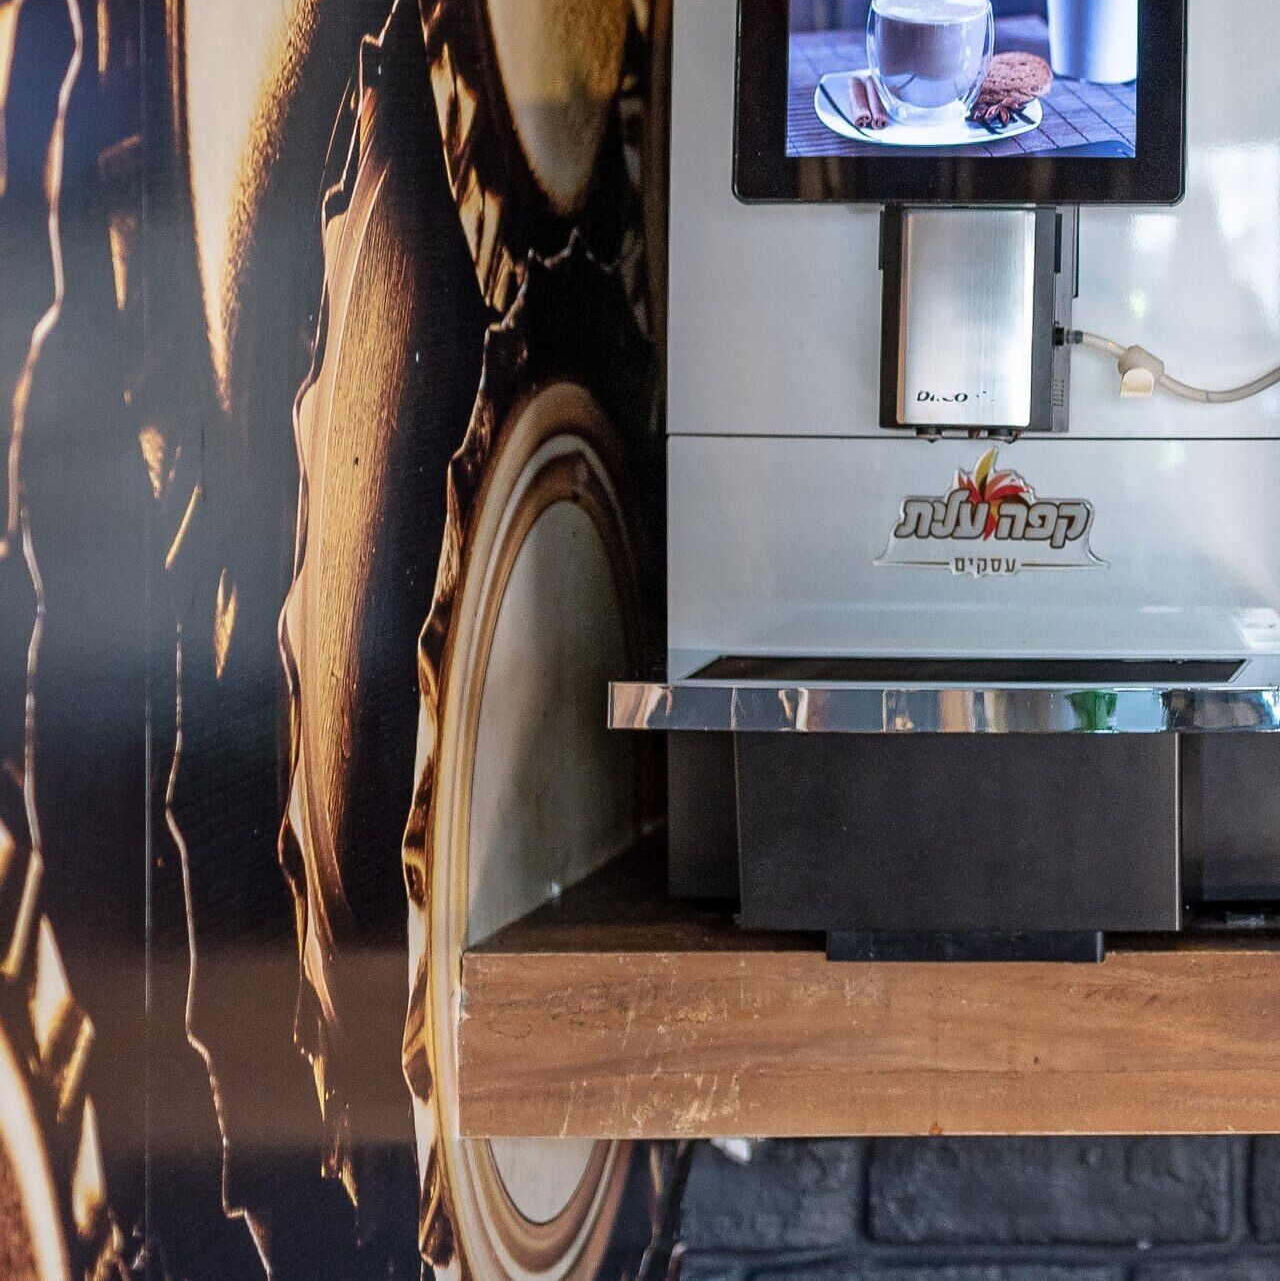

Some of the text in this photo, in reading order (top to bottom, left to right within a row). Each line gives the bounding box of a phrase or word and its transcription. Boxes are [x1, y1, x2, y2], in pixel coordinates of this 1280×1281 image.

[894, 488, 1091, 549] קפה עלית
[954, 557, 1016, 573] עסקים
